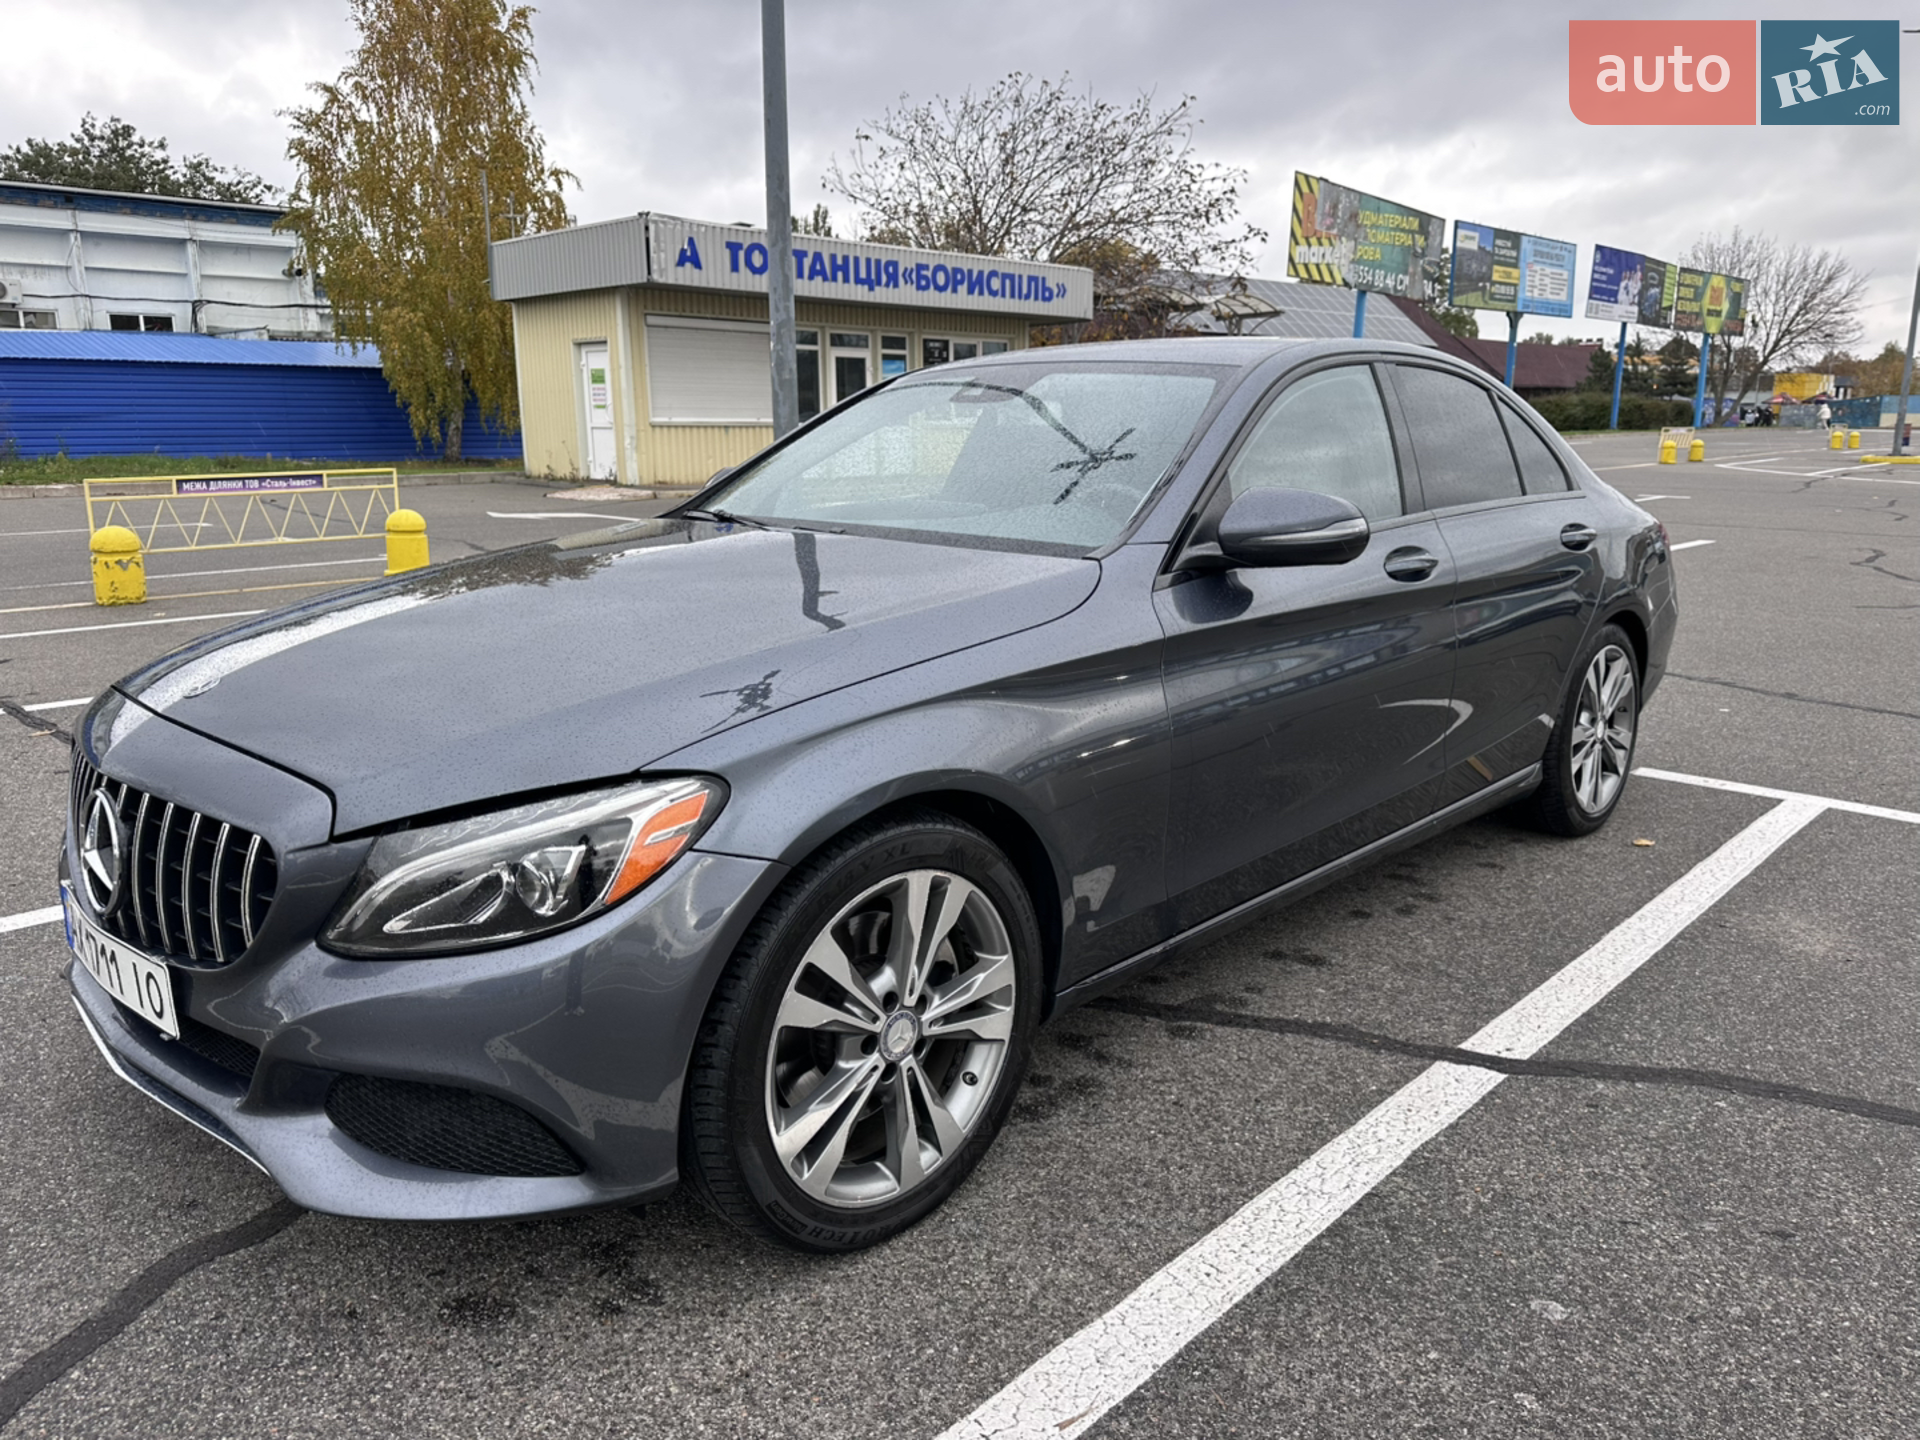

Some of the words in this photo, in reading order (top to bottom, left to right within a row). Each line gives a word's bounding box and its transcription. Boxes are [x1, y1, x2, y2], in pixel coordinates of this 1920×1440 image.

[1358, 210, 1420, 231] УДМАТЕРІАЛИ
[1353, 246, 1381, 261] РОВА
[725, 240, 900, 292] ТОТАНЦІЯ
[901, 262, 1067, 303] «БОРИСПІЛЬ»
[182, 481, 208, 492] МЕЖА
[209, 480, 244, 491] ДІЛЯНКИ
[244, 479, 260, 489] ТОВ
[261, 478, 317, 488] «Сталь-Інвест»
